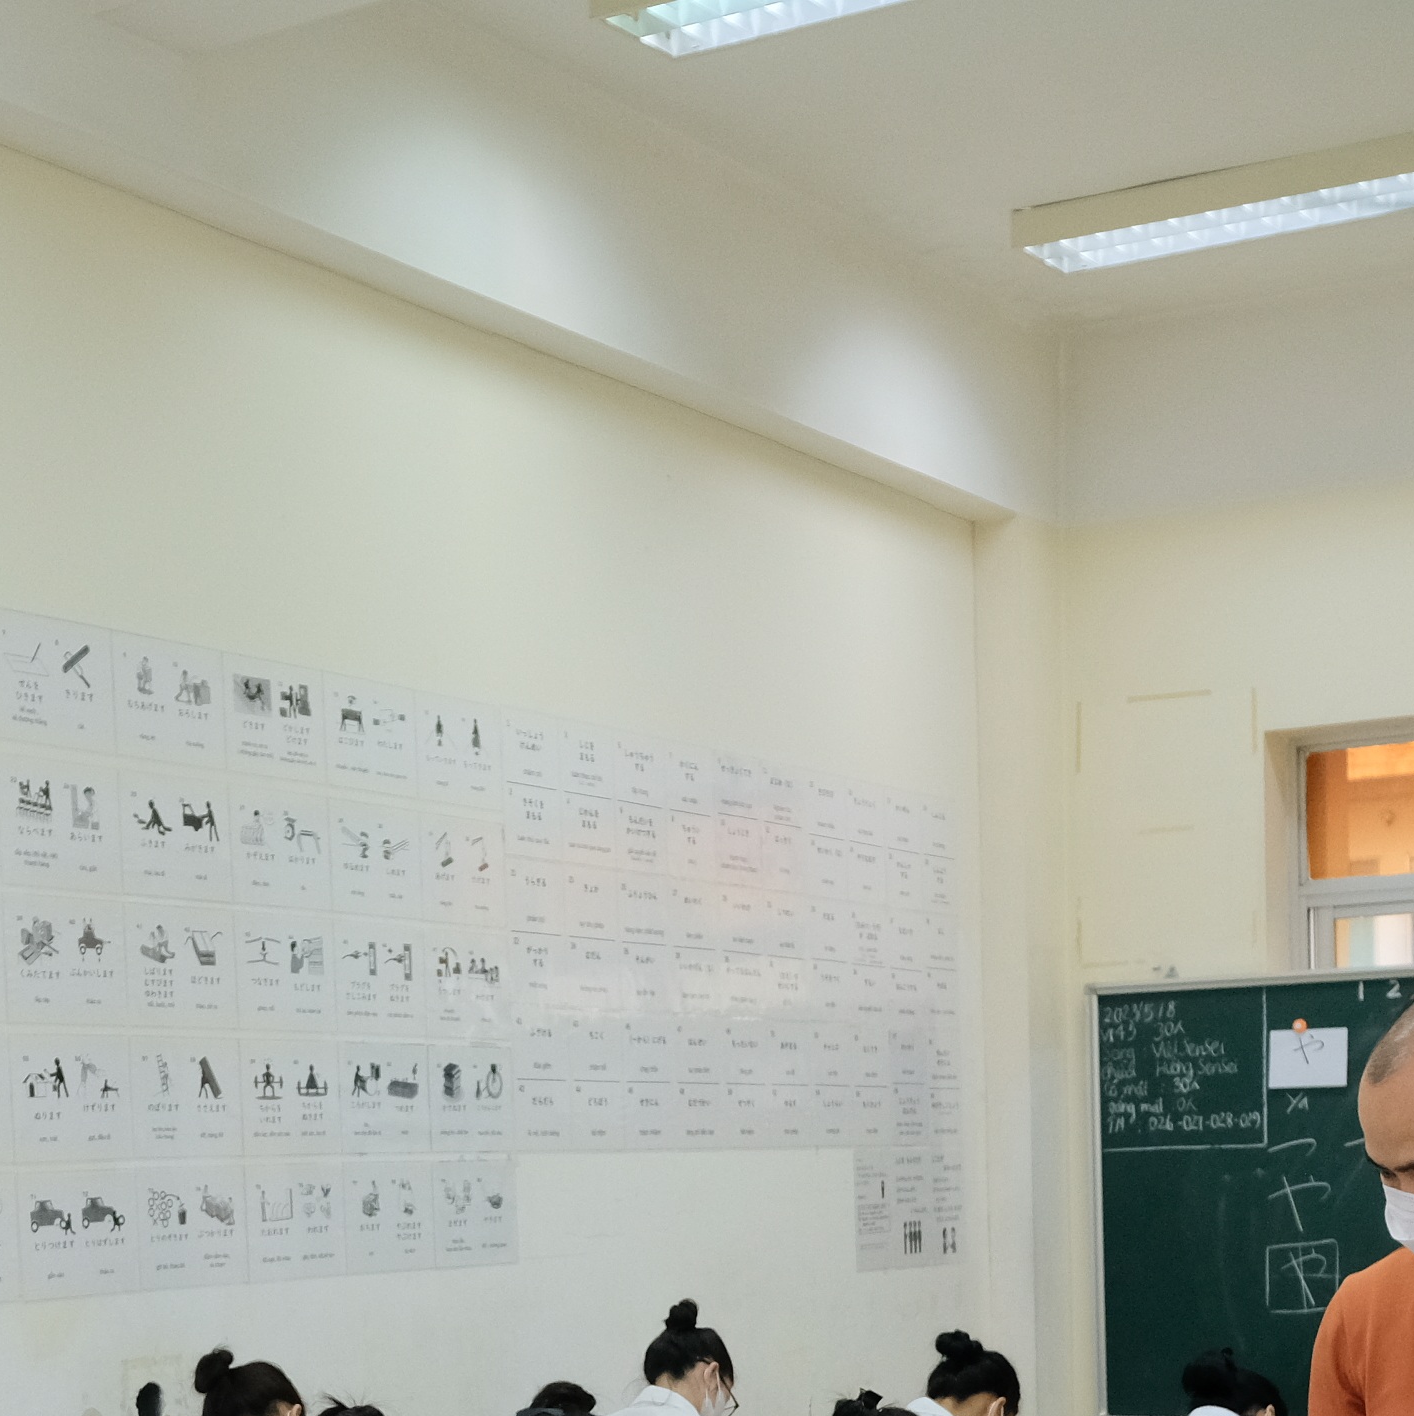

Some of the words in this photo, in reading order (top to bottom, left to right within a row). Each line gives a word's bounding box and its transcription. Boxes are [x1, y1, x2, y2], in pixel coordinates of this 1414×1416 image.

[1358, 981, 1365, 1001] 1
[1387, 980, 1402, 998] 2
[1293, 1033, 1325, 1065] や
[1268, 1175, 1332, 1233] や
